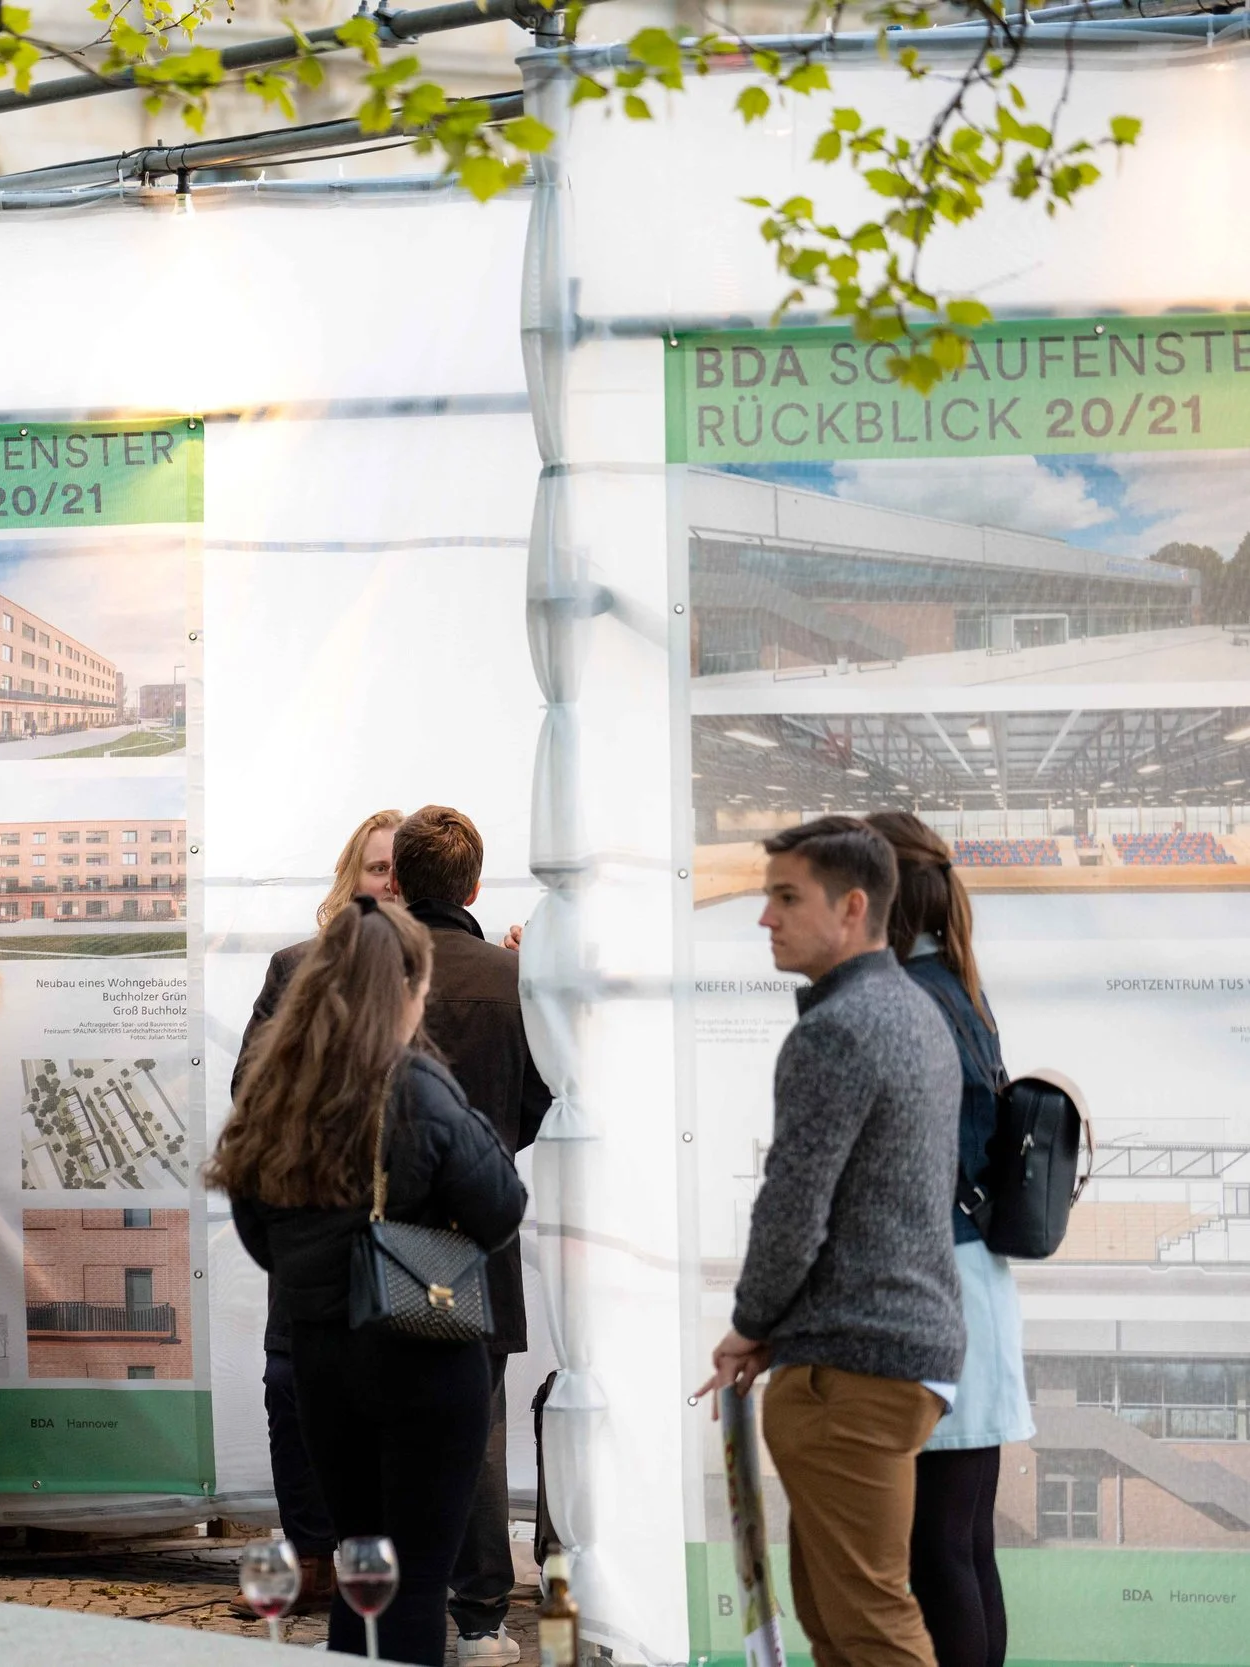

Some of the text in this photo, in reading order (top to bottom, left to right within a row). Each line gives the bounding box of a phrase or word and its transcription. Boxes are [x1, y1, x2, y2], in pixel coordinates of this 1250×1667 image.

[695, 330, 1250, 389] BDA SCAUFENSTE
[698, 392, 1201, 448] RÜCKBLICK 20/21
[36, 978, 187, 990] Neubau eines Wohngebäudes
[695, 981, 736, 992] KIEFER
[1106, 978, 1244, 991] SPORTZENTRUM TUS
[102, 992, 187, 1002] Buchholzer Grün
[113, 1006, 187, 1016] Groß Buchholz
[31, 1418, 118, 1429] BDA Hannover
[1122, 1589, 1236, 1604] BDA Hannover
